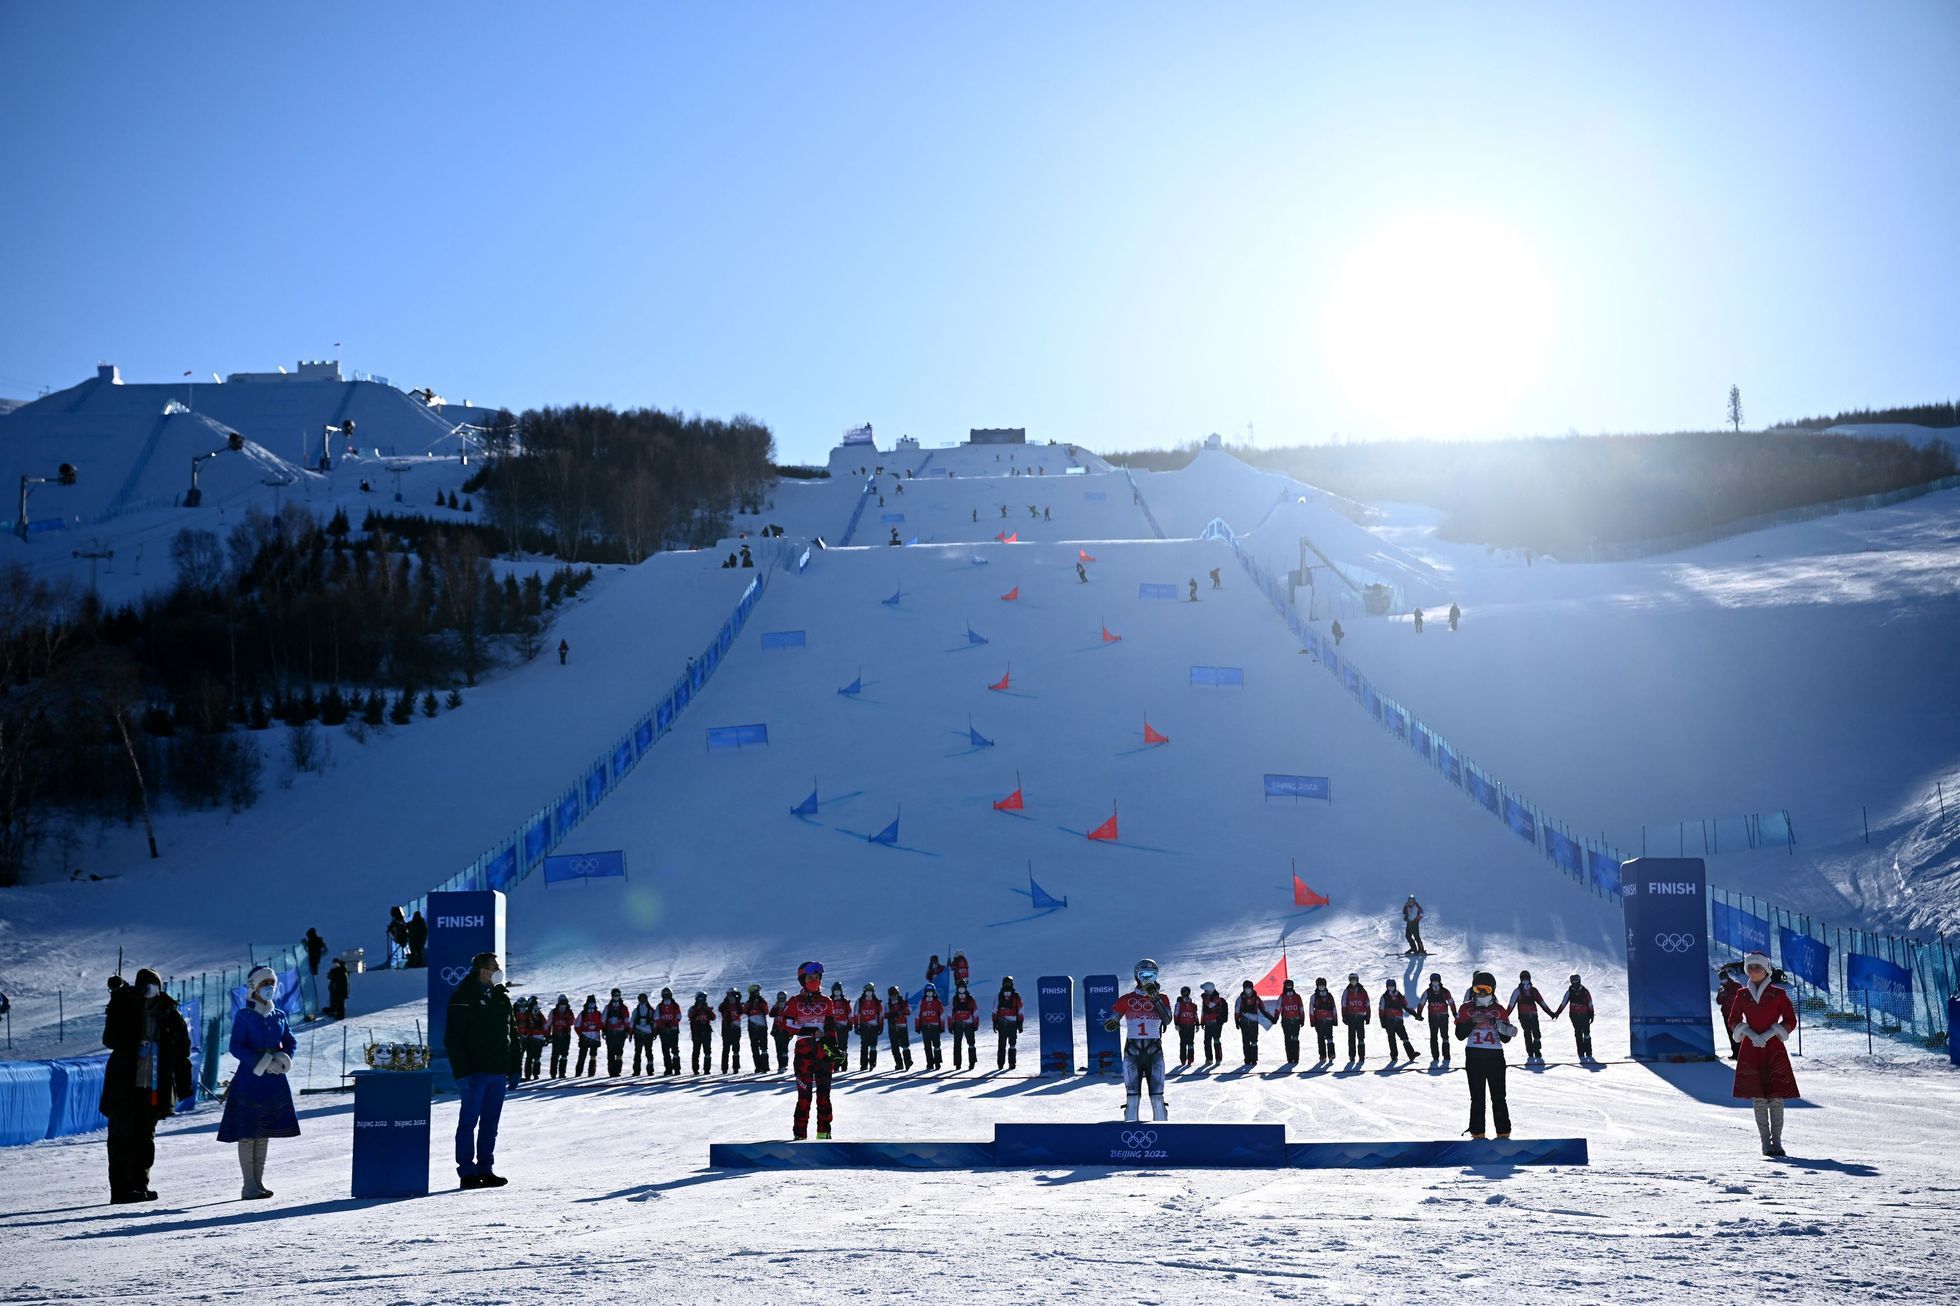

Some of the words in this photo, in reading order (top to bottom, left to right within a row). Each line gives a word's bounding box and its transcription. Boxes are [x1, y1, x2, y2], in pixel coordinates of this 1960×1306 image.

[1623, 883, 1637, 897] FINISH
[1648, 882, 1696, 895] FINISH
[437, 915, 484, 928] FINISH
[1042, 987, 1067, 995] FINISH
[1089, 986, 1114, 994] FINISH
[1137, 1022, 1148, 1036] 1
[1473, 1031, 1496, 1045] 14
[356, 1120, 374, 1128] BEIJING
[374, 1120, 388, 1128] 2022
[394, 1120, 412, 1128] BEIJING
[1110, 1150, 1142, 1160] BEIJING
[1143, 1150, 1169, 1158] 2022
